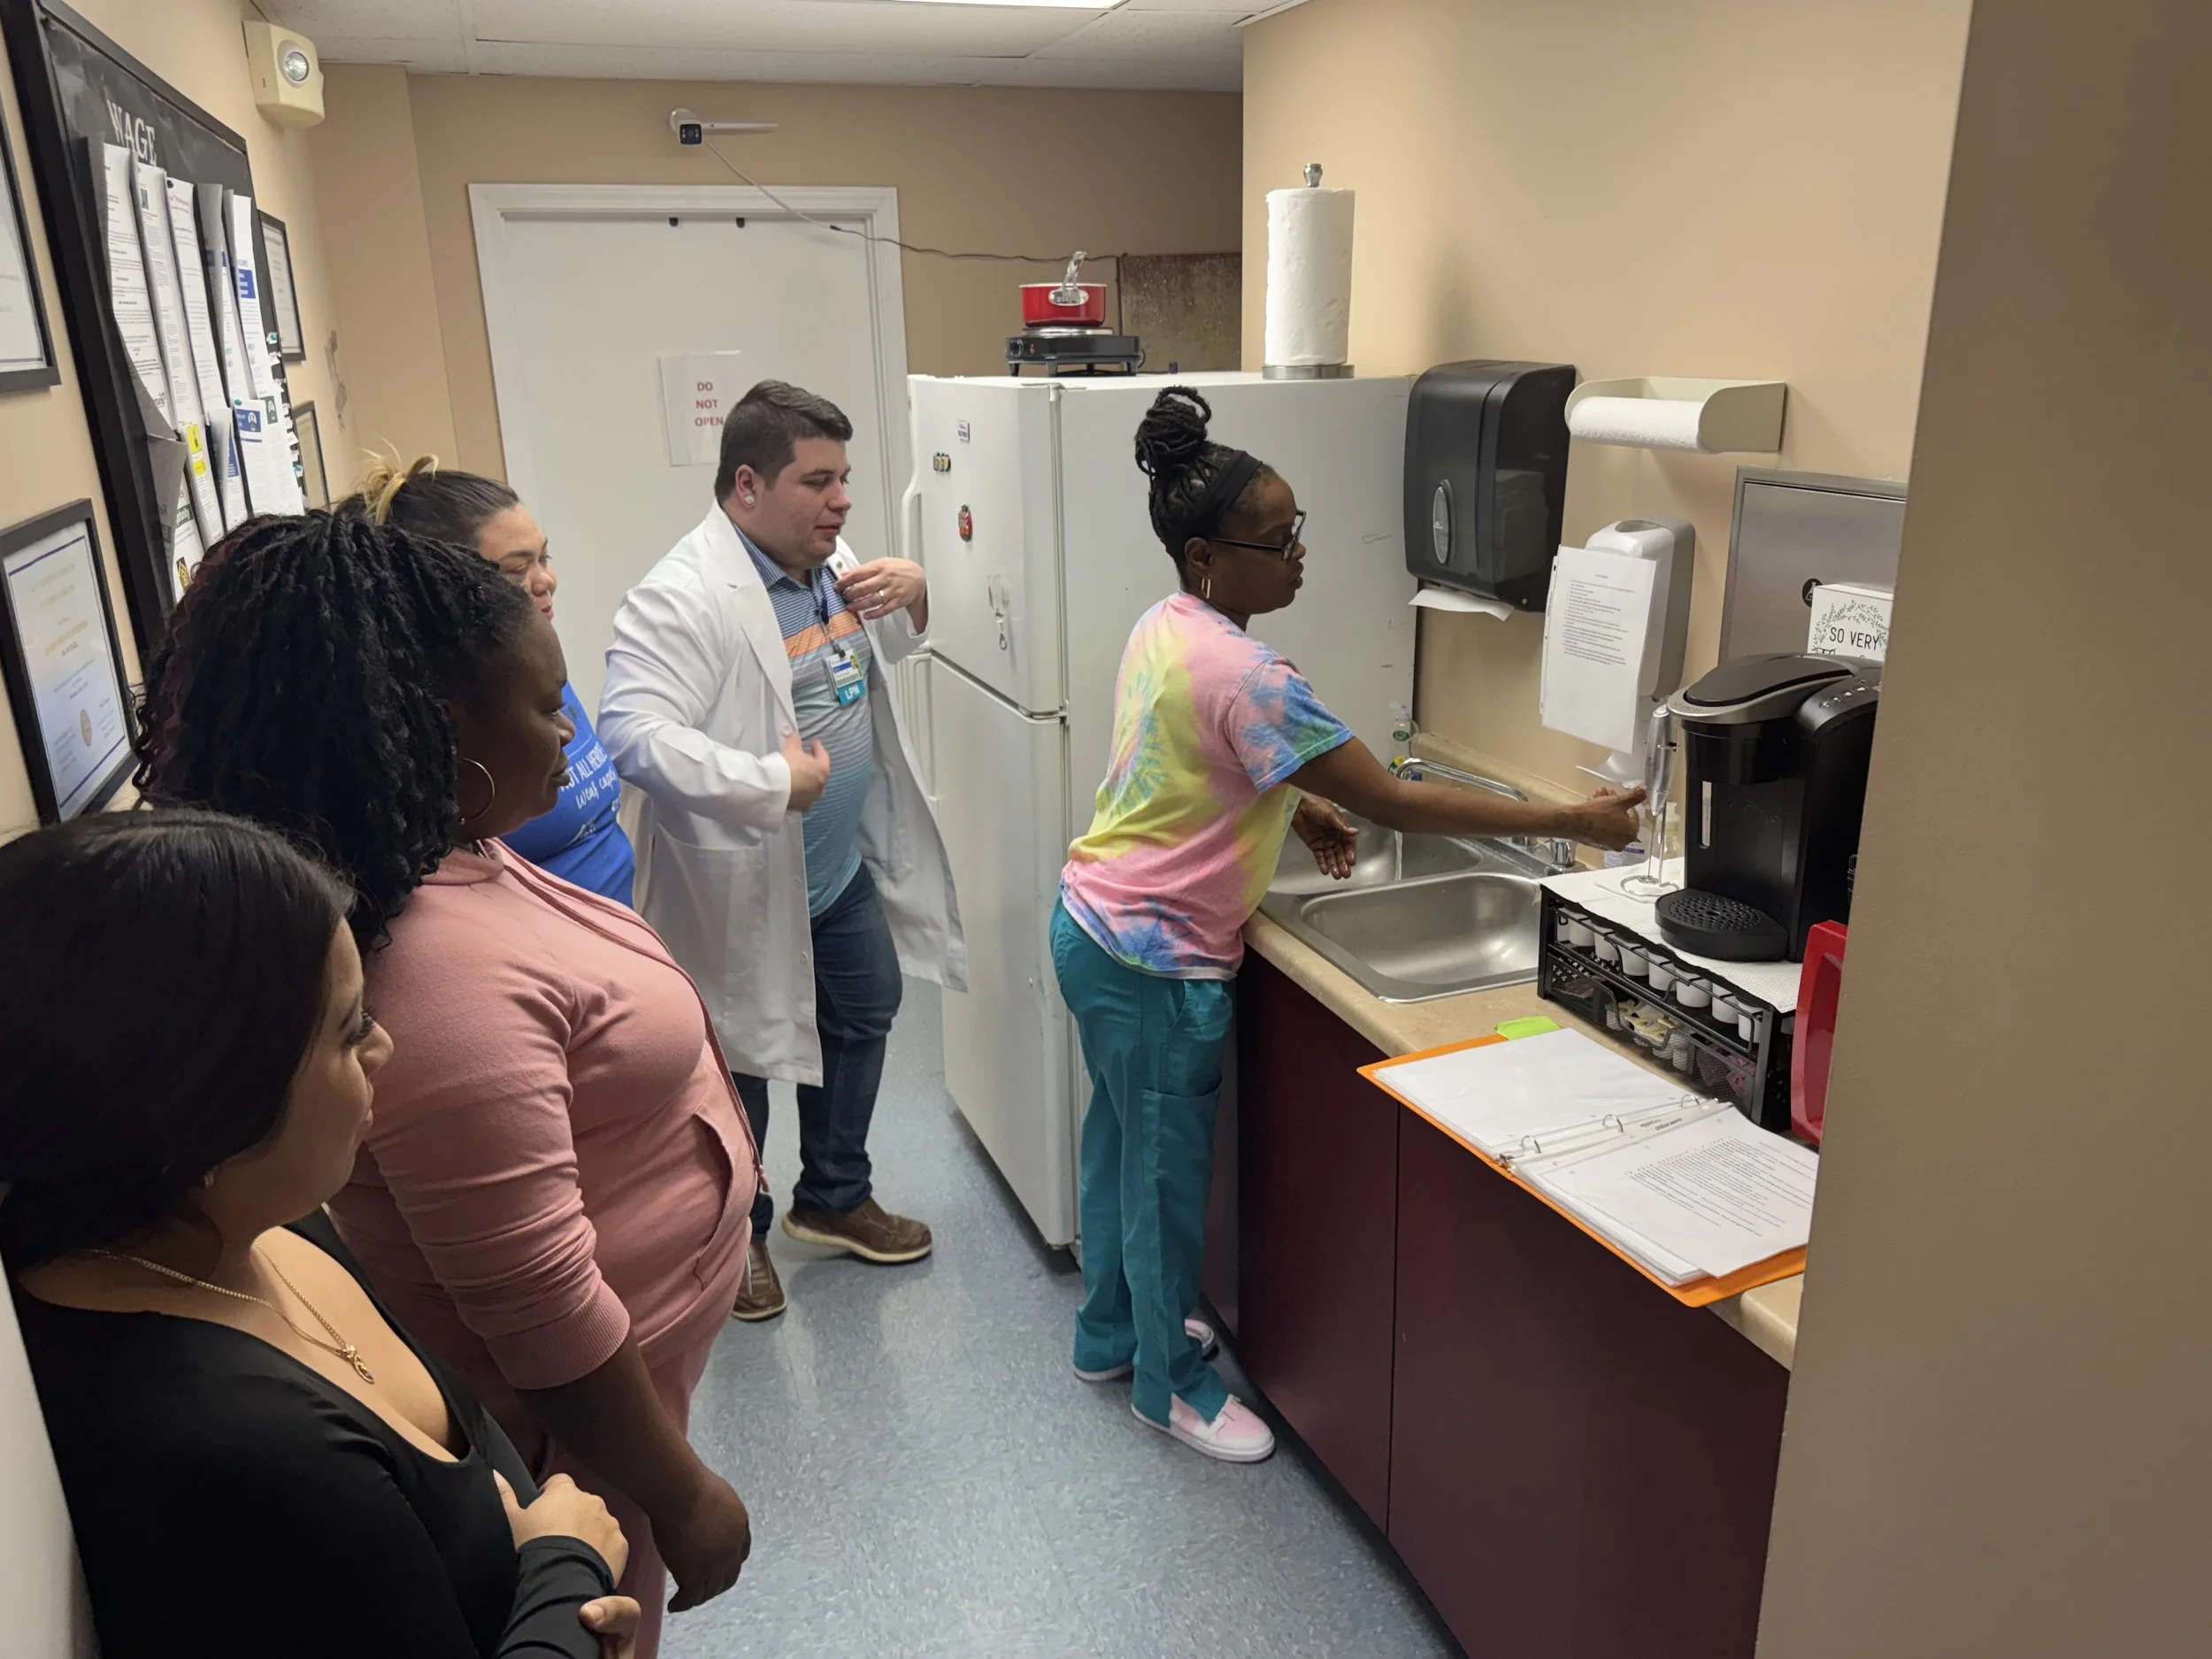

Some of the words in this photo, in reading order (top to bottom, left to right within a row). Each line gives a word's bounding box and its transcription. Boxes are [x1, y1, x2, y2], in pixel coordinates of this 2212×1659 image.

[106, 98, 157, 166] WAGE
[697, 381, 713, 392] DO
[695, 399, 718, 409] NOT
[695, 417, 724, 426] OPEN
[1829, 626, 1845, 643] SO
[1849, 631, 1879, 651] VERY
[844, 684, 860, 701] LPN
[575, 758, 594, 781] ALL
[586, 741, 608, 772] HEROE
